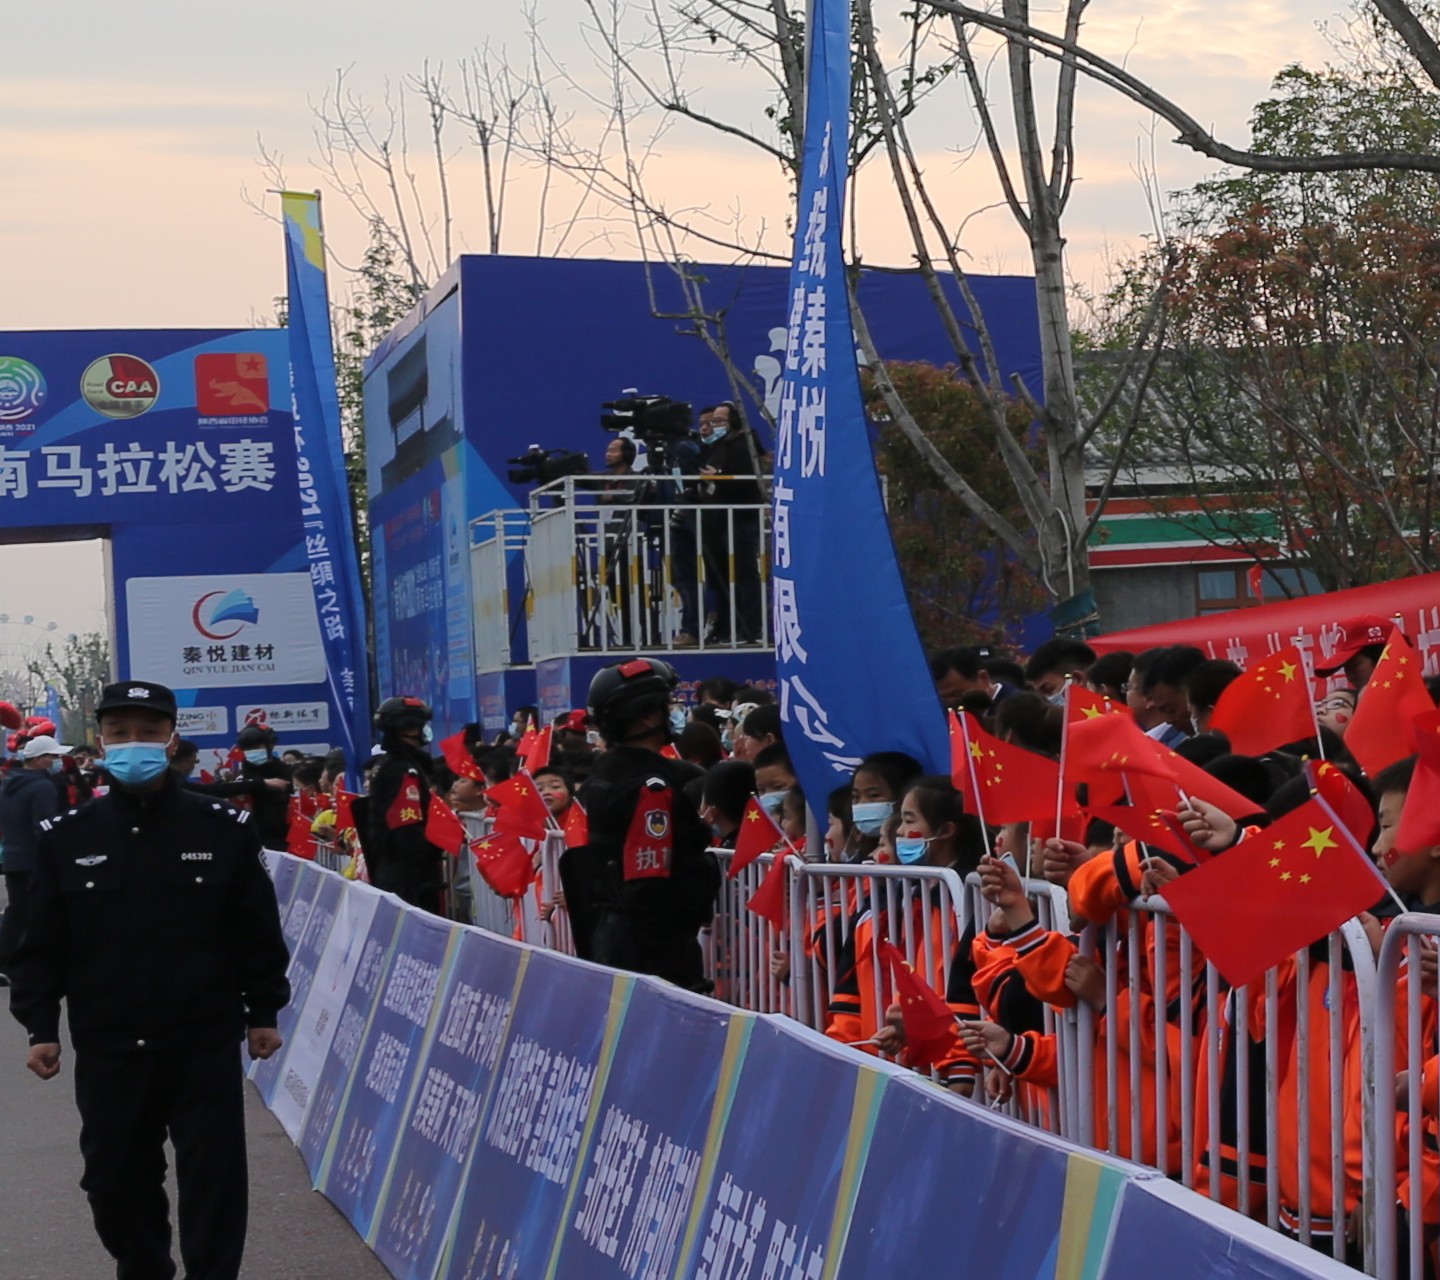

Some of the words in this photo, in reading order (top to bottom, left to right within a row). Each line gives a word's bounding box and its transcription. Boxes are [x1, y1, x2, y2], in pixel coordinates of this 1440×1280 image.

[110, 380, 154, 394] CAA
[182, 644, 275, 663] 秦悦建材
[183, 664, 206, 675] QIN
[206, 664, 228, 674] YUE
[230, 663, 256, 674] JIAN
[257, 663, 275, 672] CAI
[485, 1033, 552, 1164] 庆祝建党百年
[574, 1103, 650, 1260] 当好东道主
